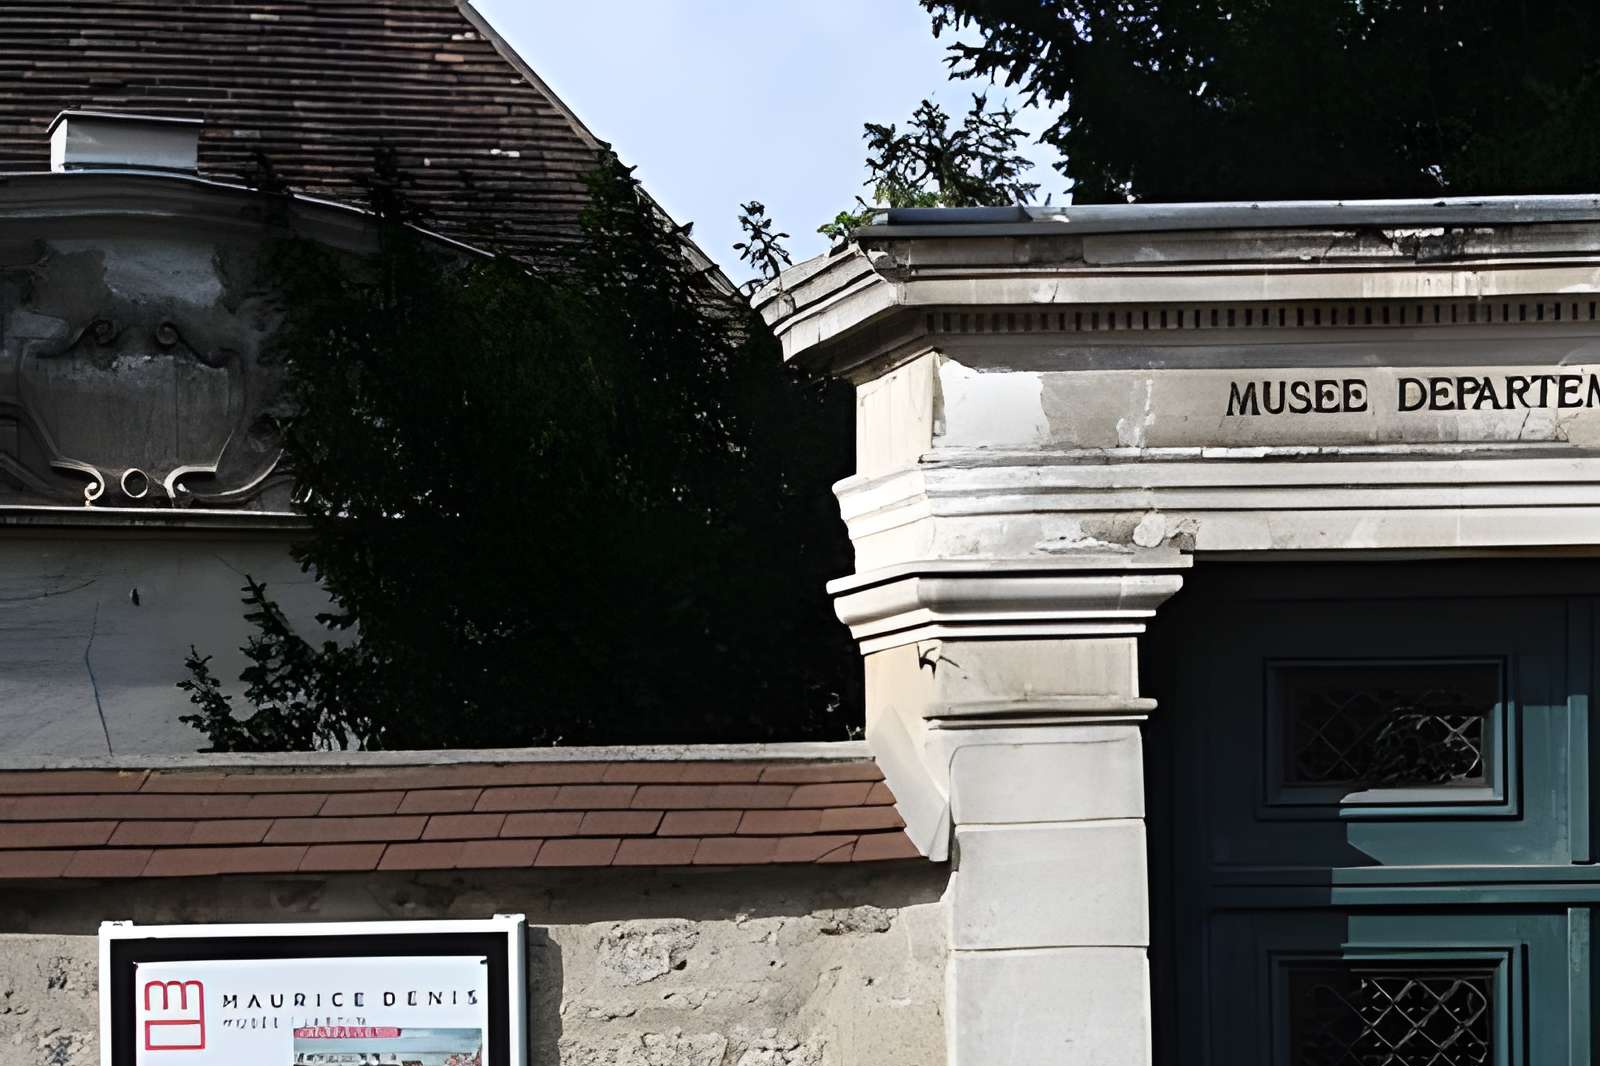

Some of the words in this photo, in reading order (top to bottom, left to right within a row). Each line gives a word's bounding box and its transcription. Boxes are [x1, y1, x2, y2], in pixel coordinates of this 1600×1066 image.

[1226, 379, 1367, 417] MUSEE
[222, 990, 366, 1010] MAURICE
[383, 988, 479, 1007] DENIS
